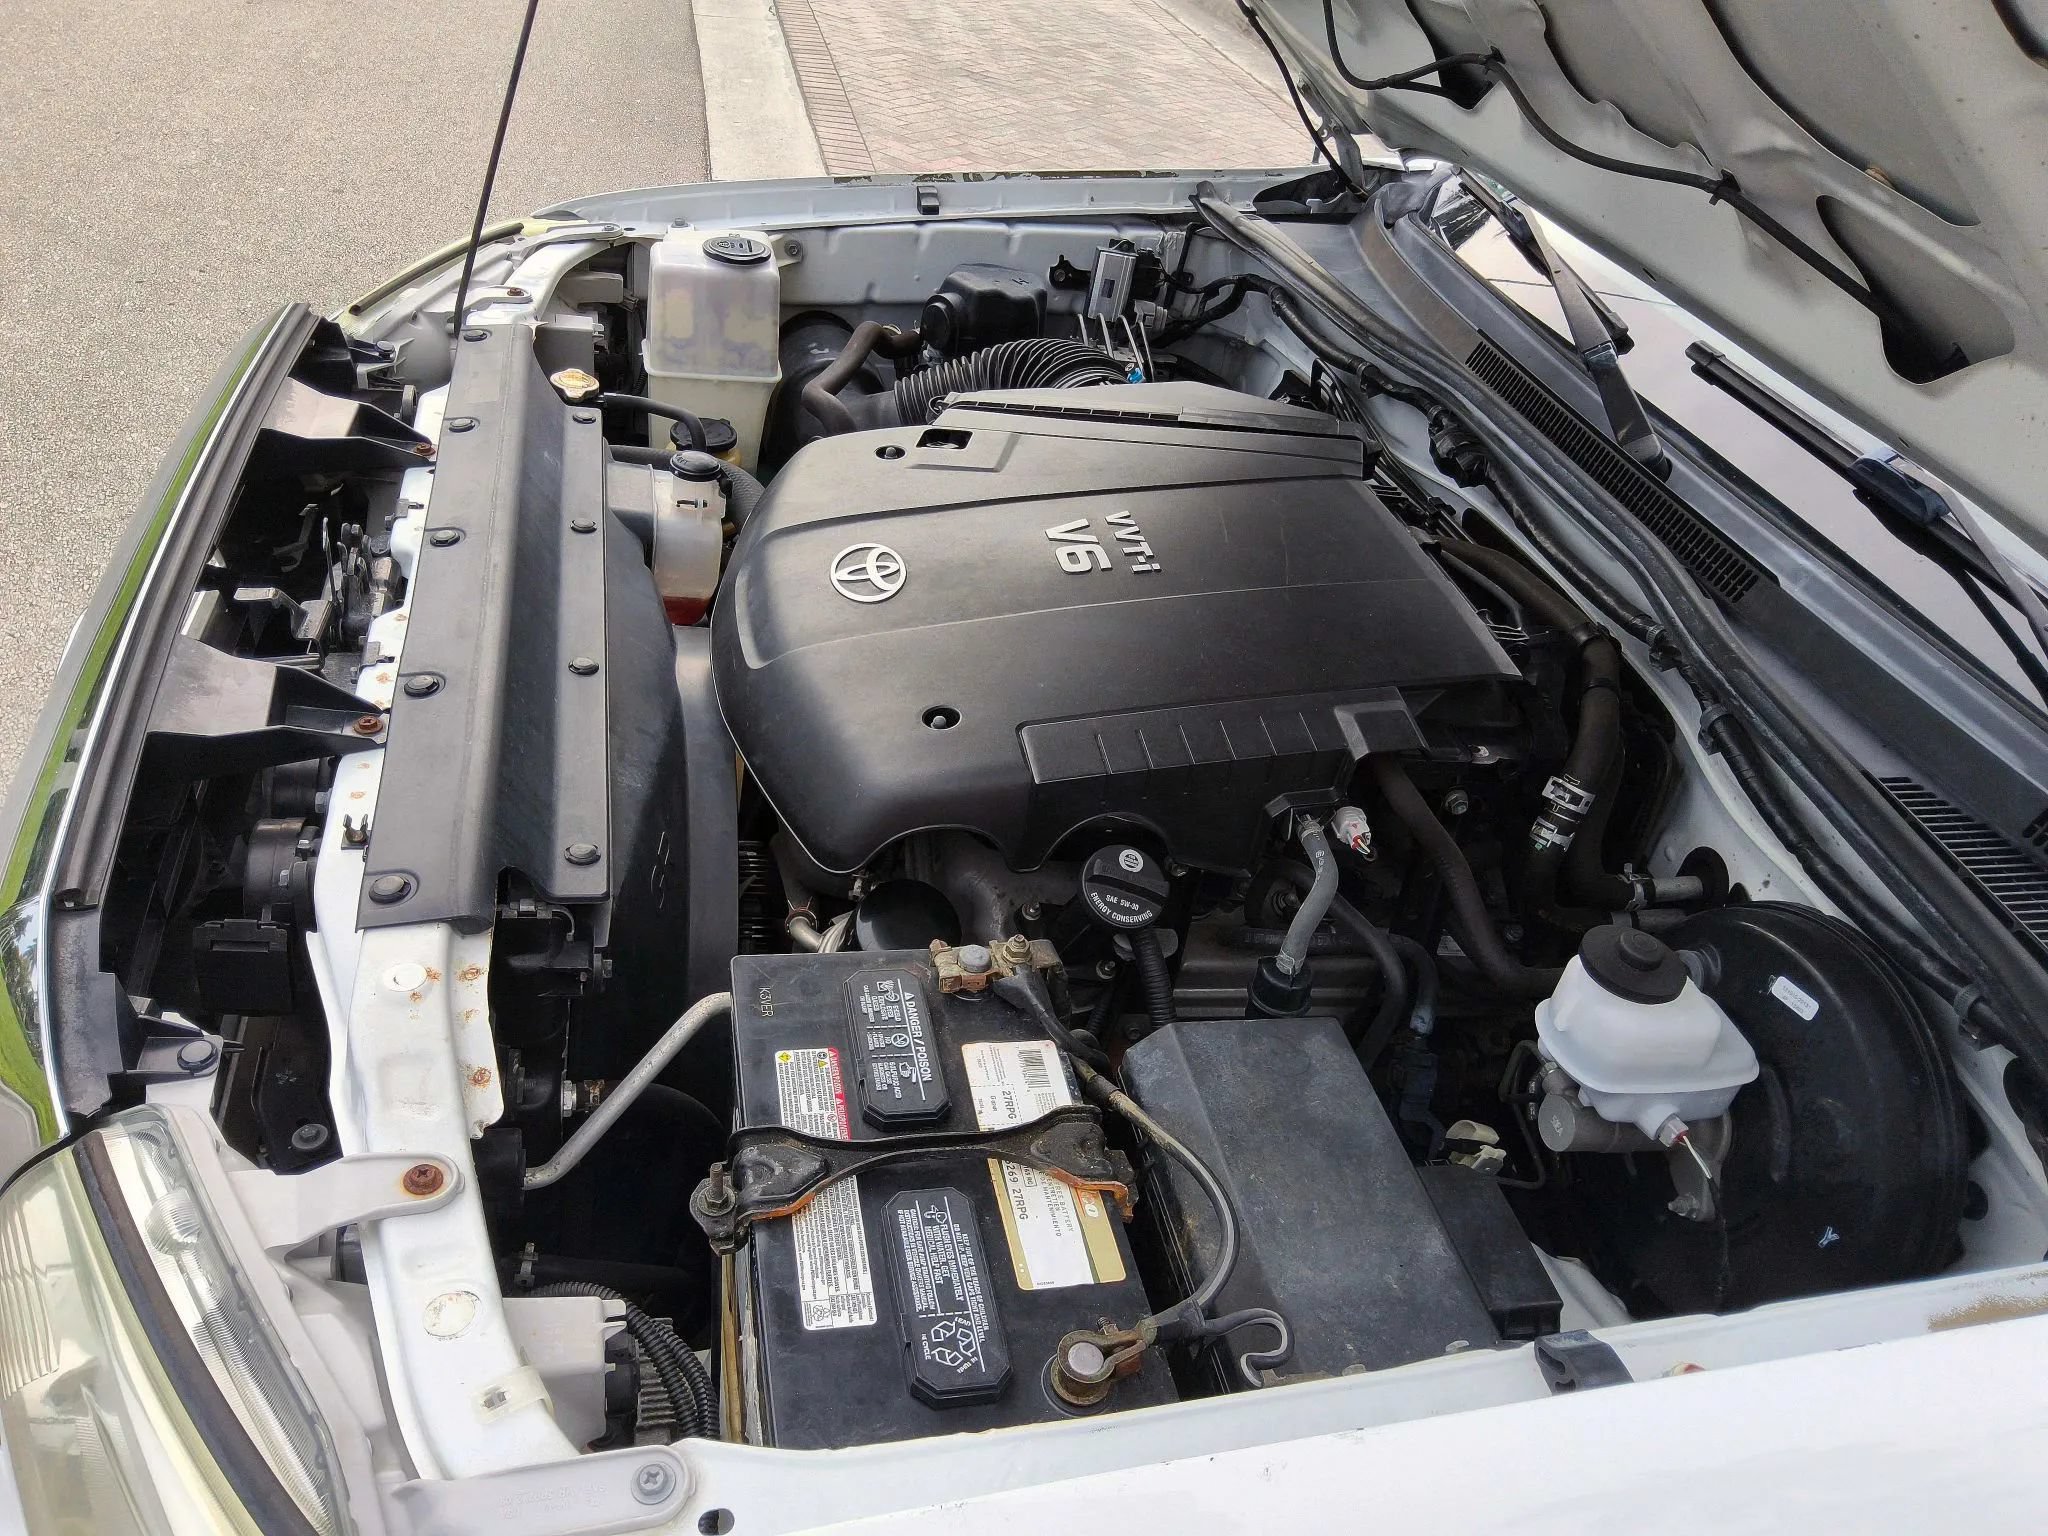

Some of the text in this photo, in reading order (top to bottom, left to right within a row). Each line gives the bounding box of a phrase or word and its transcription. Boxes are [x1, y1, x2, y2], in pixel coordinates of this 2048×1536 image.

[1045, 518, 1113, 574] V6
[1090, 891, 1153, 923] ENERGY CONSERVING
[1105, 894, 1139, 911] SAE 5W-30
[1001, 1090, 1016, 1119] 27RPG
[1026, 1176, 1033, 1185] RC
[1047, 1178, 1061, 1211] ENTRETIEN
[1012, 1188, 1029, 1220] 27RPG
[1043, 1186, 1062, 1237] MANTENIMIENTO
[1060, 1202, 1074, 1232] BATTERY
[924, 1226, 943, 1284] MEDICAL HELP FAST
[932, 1225, 942, 1240] WITH
[941, 1265, 950, 1277] GET
[941, 1224, 965, 1301] FLUSH EYES IMMEDIATELY
